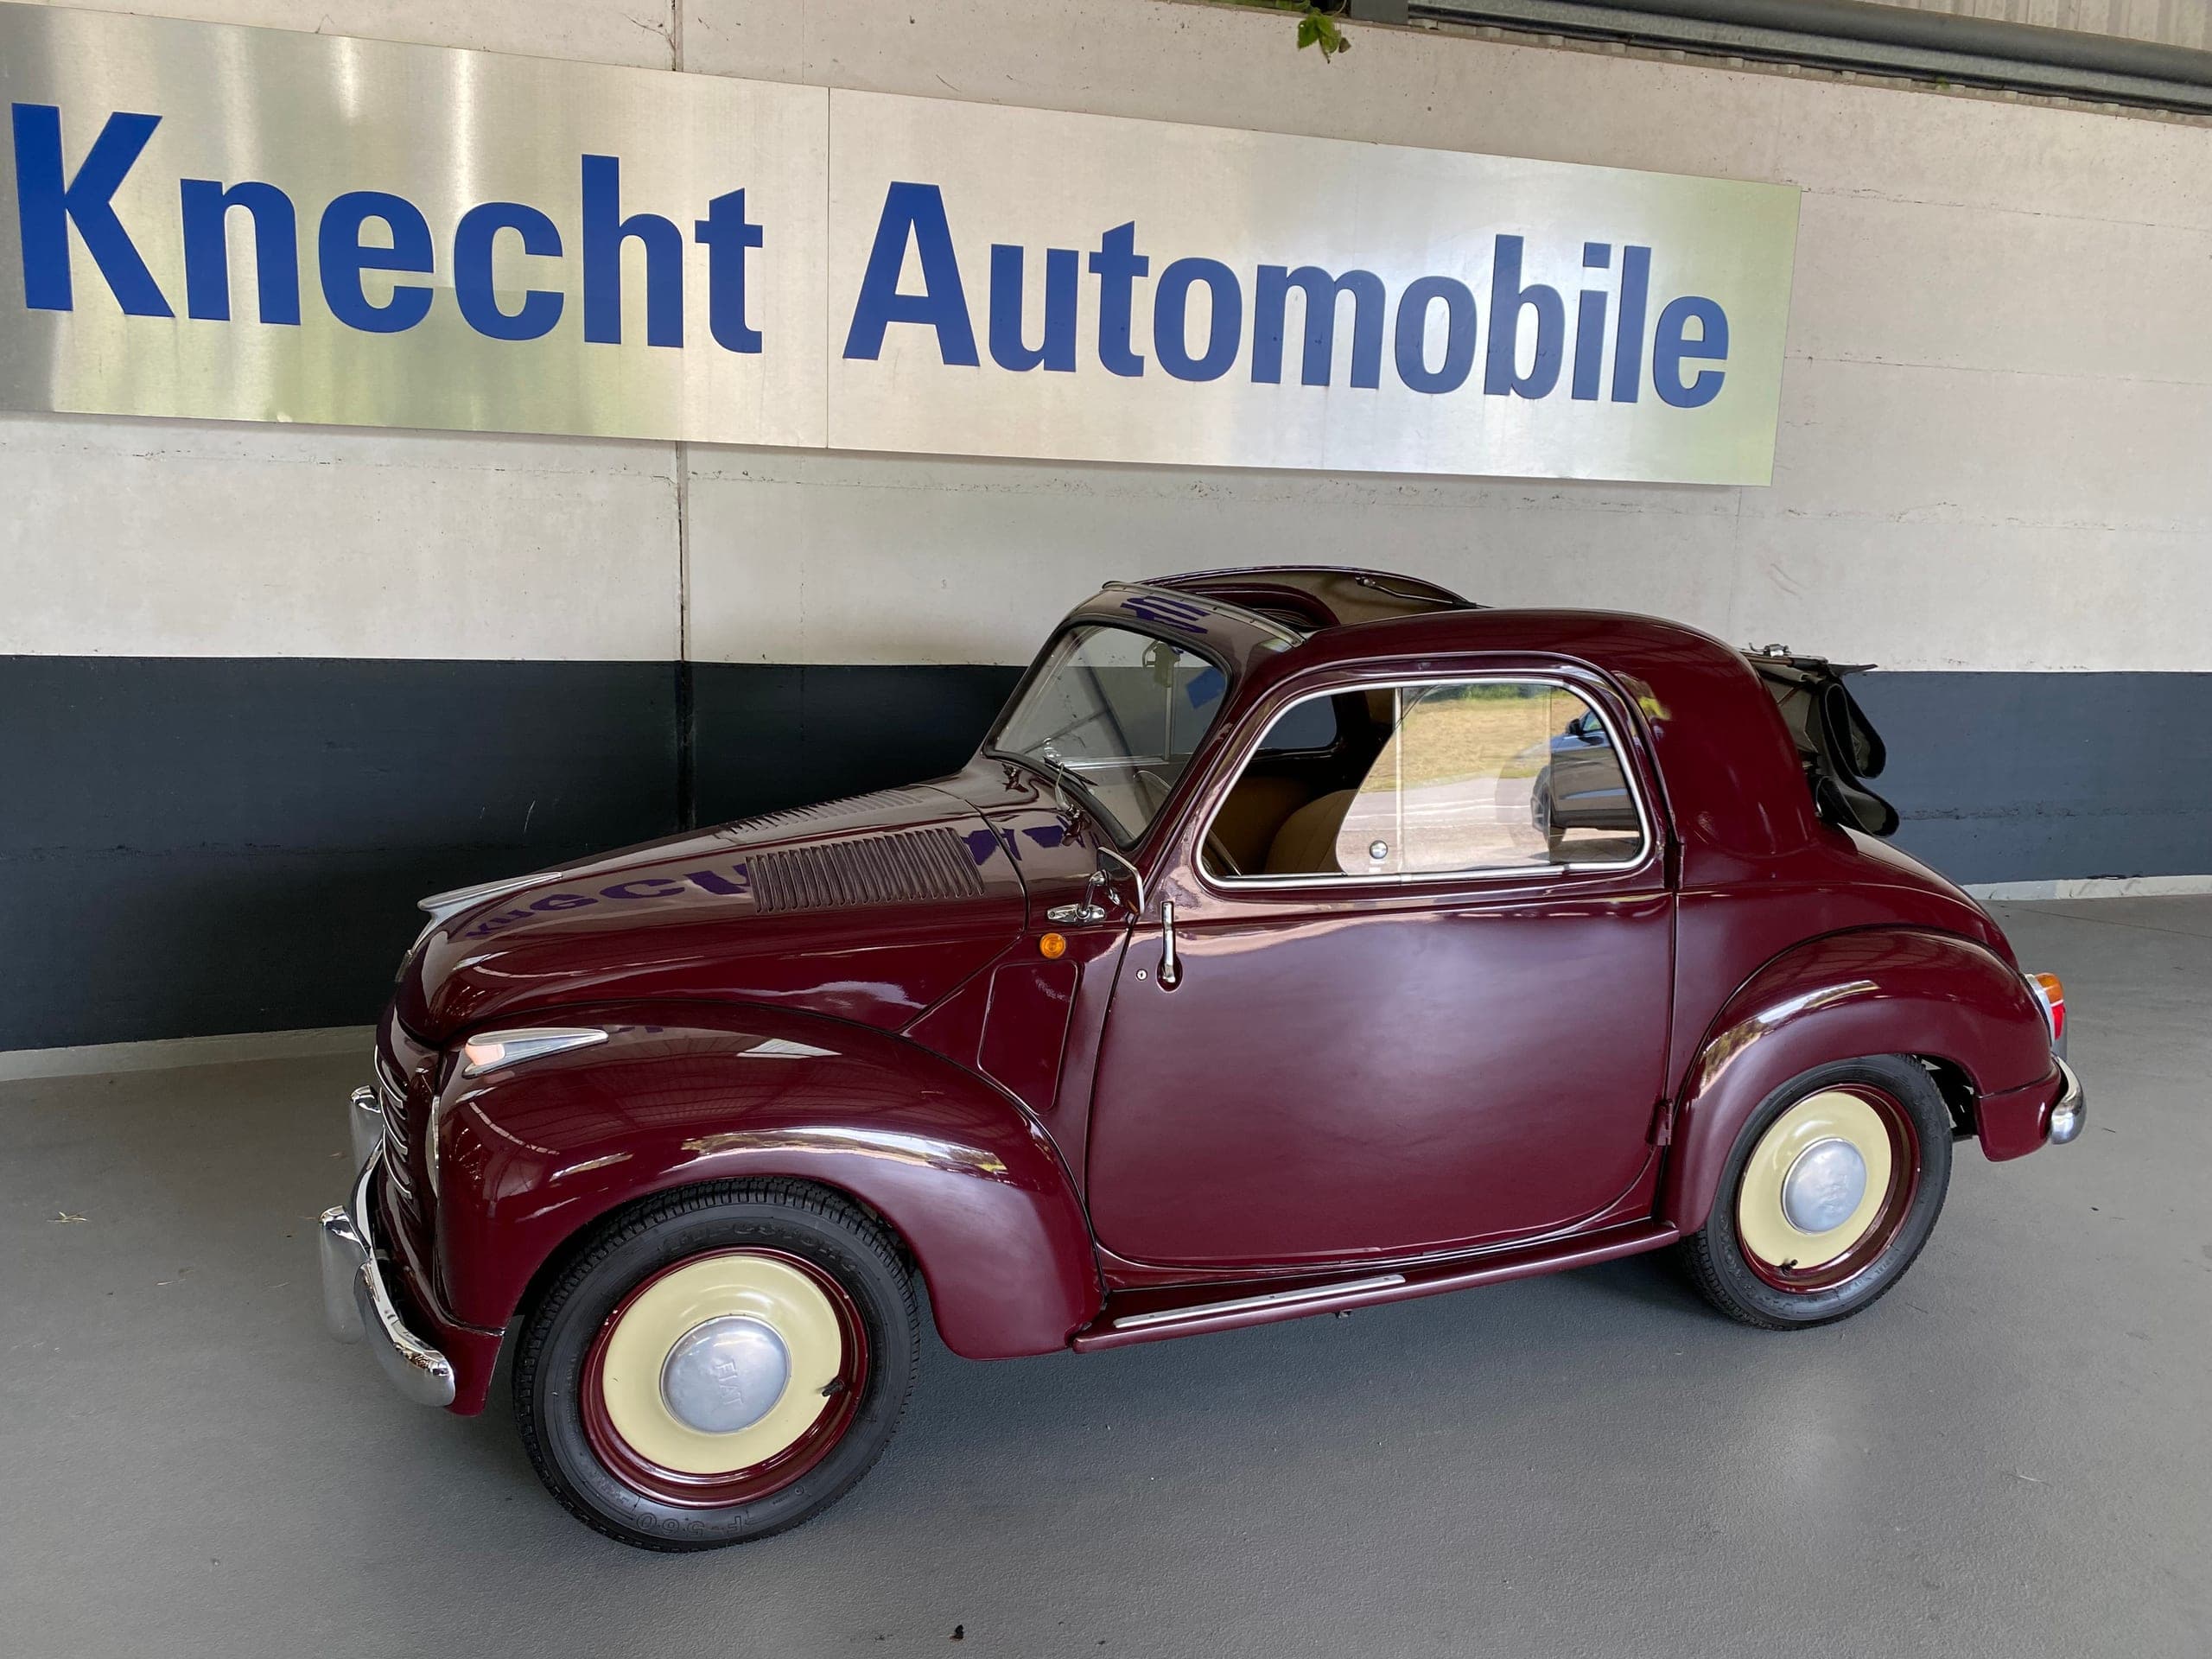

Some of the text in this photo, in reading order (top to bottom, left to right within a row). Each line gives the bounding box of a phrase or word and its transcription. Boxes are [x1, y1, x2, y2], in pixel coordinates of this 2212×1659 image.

[12, 102, 1729, 409] Knecht Automobile
[712, 1358, 745, 1406] FIAT
